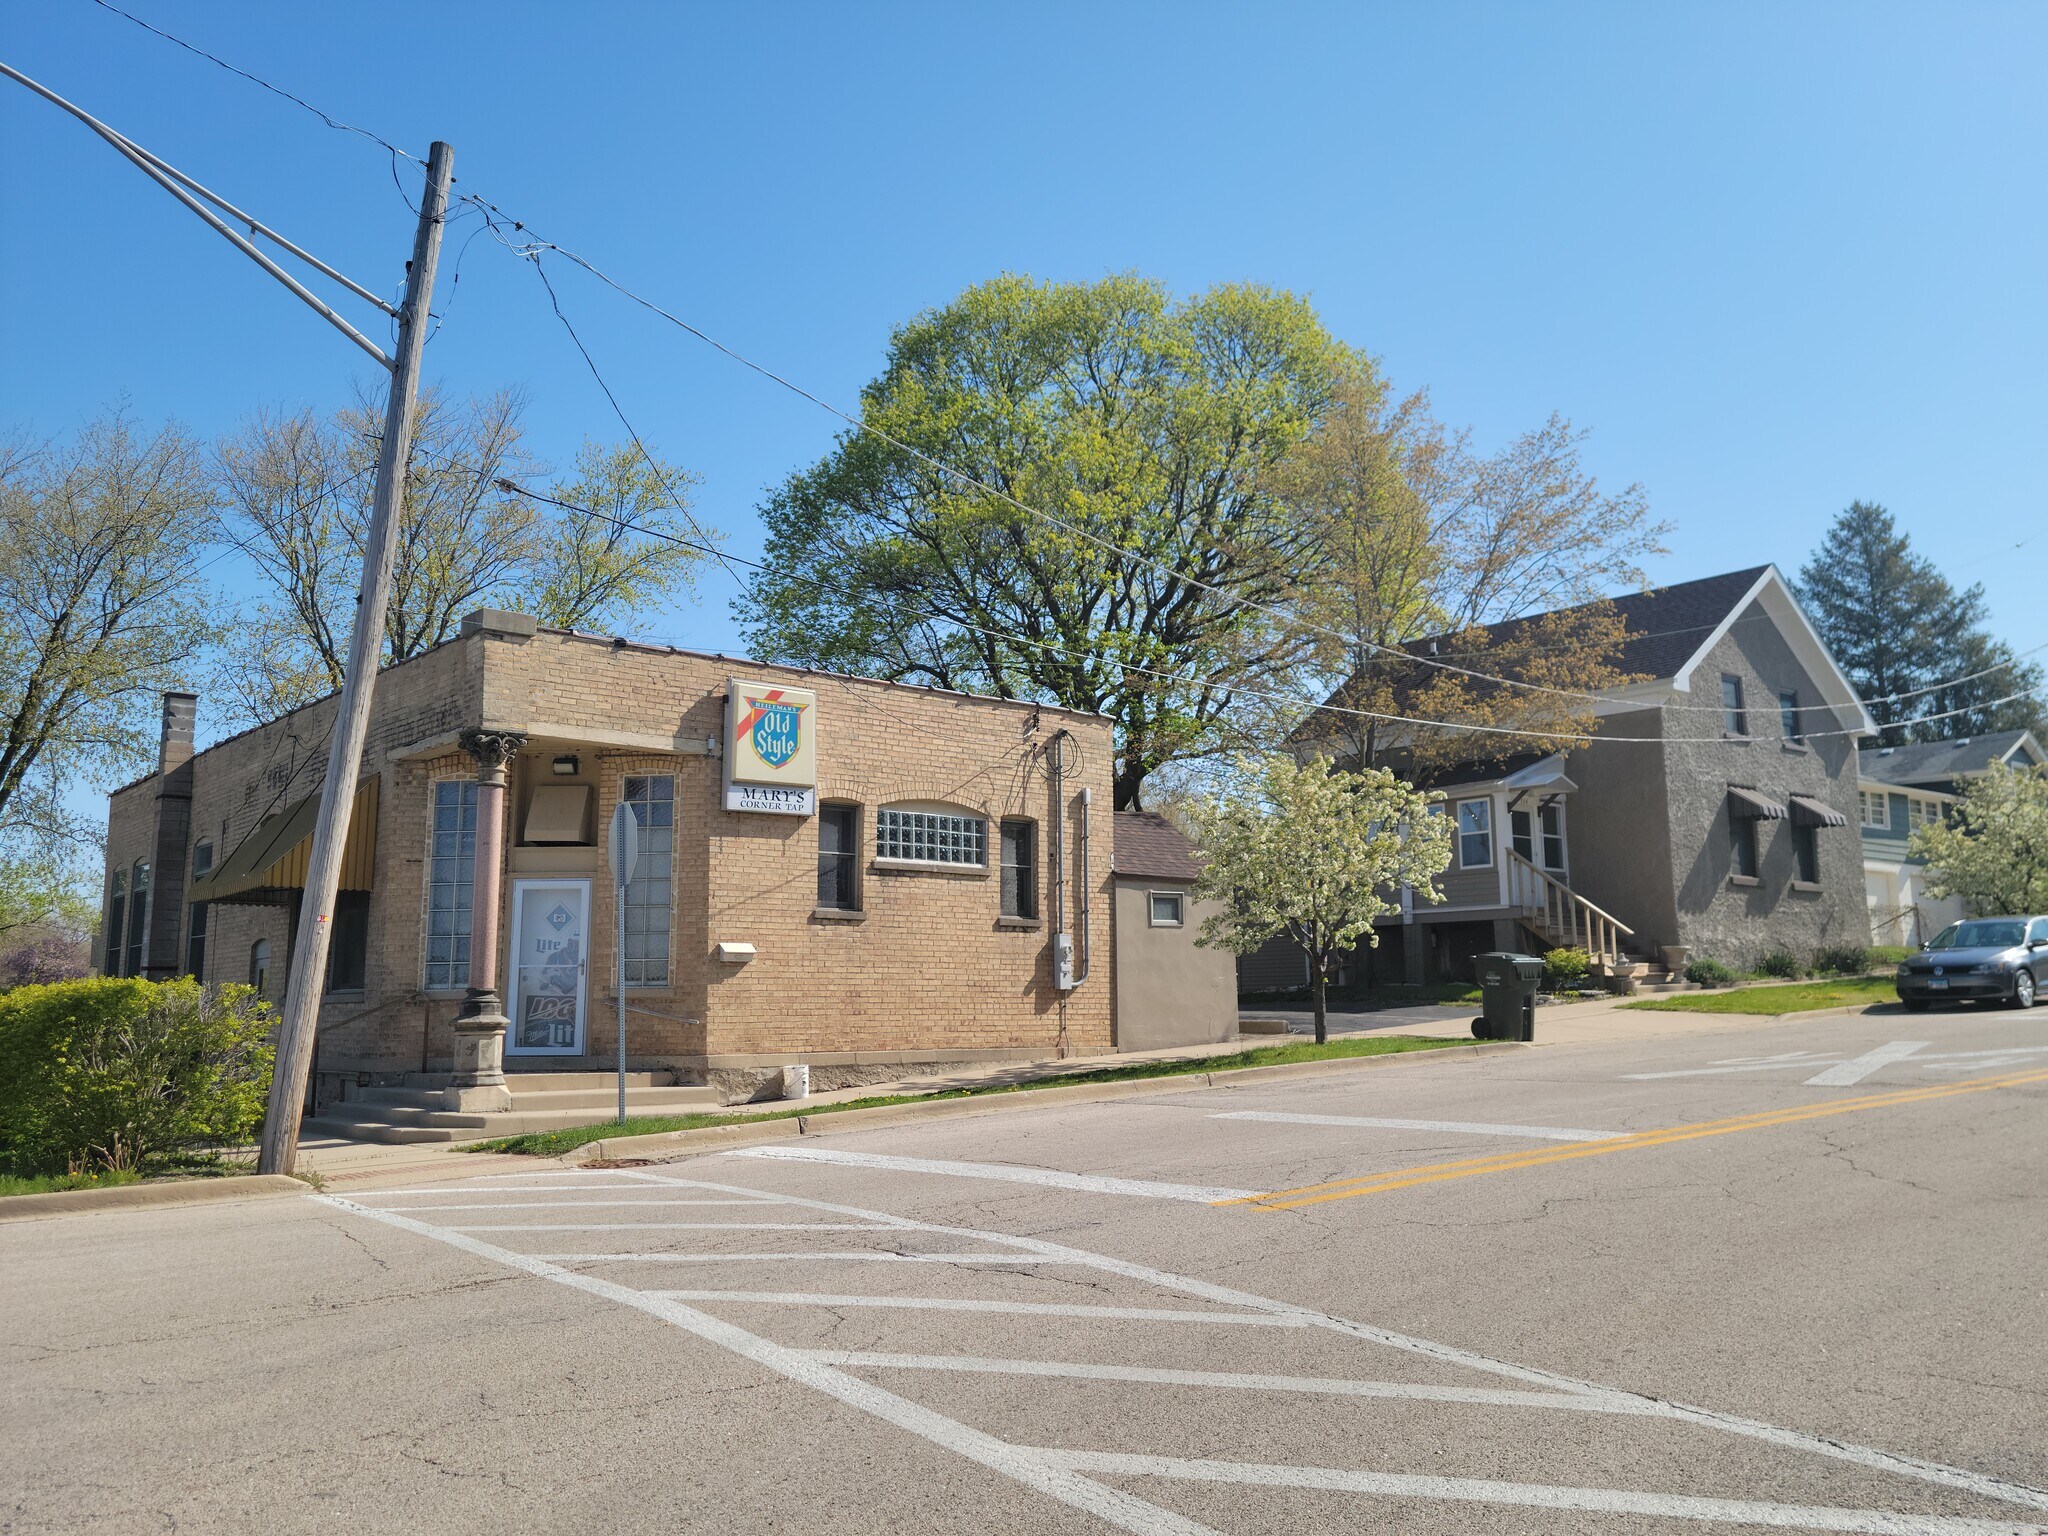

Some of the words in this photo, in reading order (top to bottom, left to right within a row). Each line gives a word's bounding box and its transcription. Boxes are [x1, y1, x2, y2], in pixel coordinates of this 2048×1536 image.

[764, 711, 790, 733] Old
[757, 729, 795, 762] Style
[742, 787, 805, 804] MARY'S
[740, 800, 782, 811] CORNER
[785, 803, 804, 812] TAP
[535, 938, 561, 954] Lite
